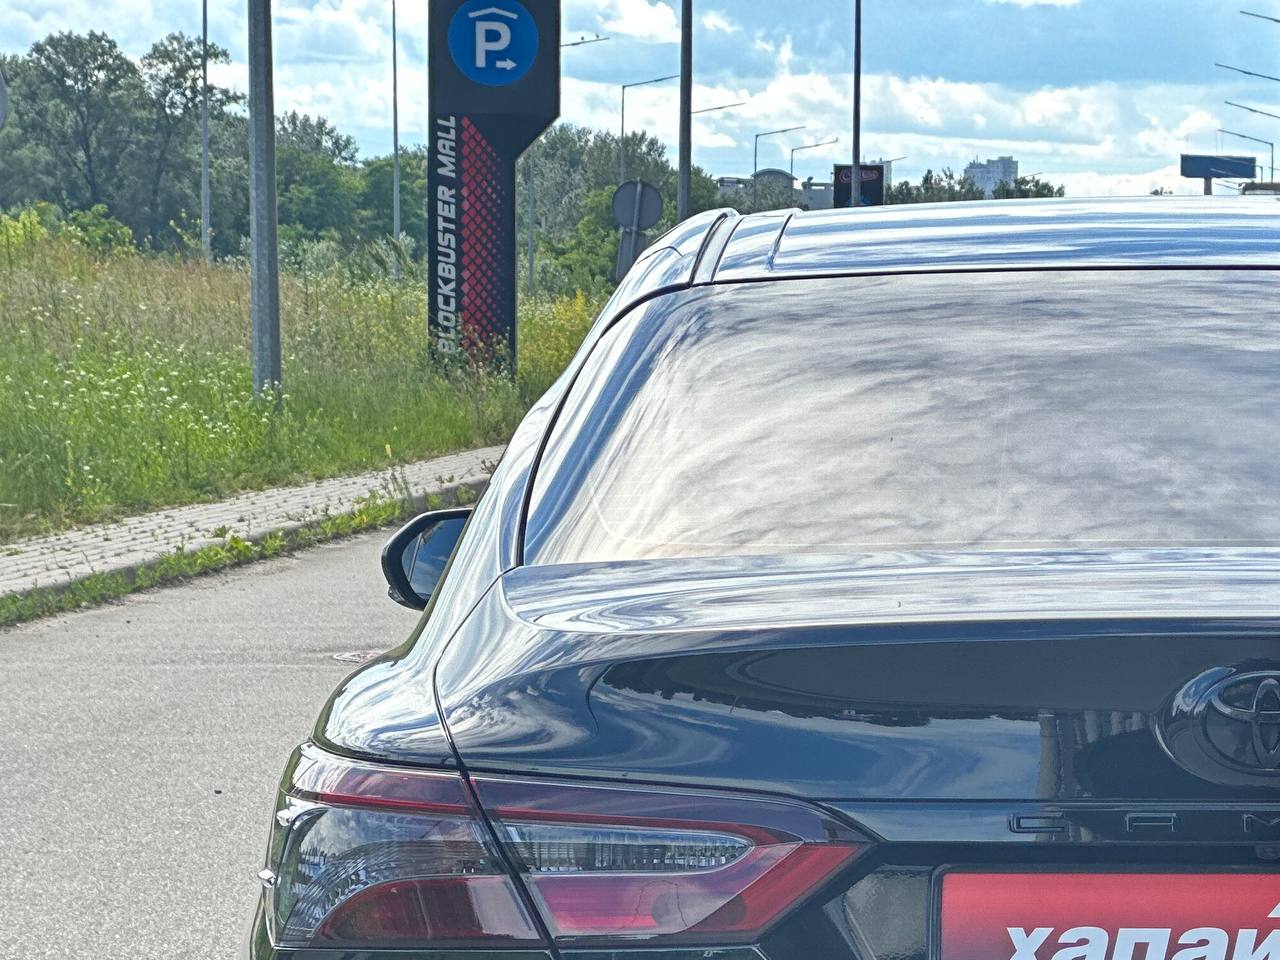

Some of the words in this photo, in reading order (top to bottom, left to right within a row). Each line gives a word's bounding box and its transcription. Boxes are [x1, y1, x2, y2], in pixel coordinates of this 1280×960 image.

[475, 21, 511, 68] P
[437, 115, 456, 179] MALL
[437, 185, 456, 354] BLOCKBUSTER
